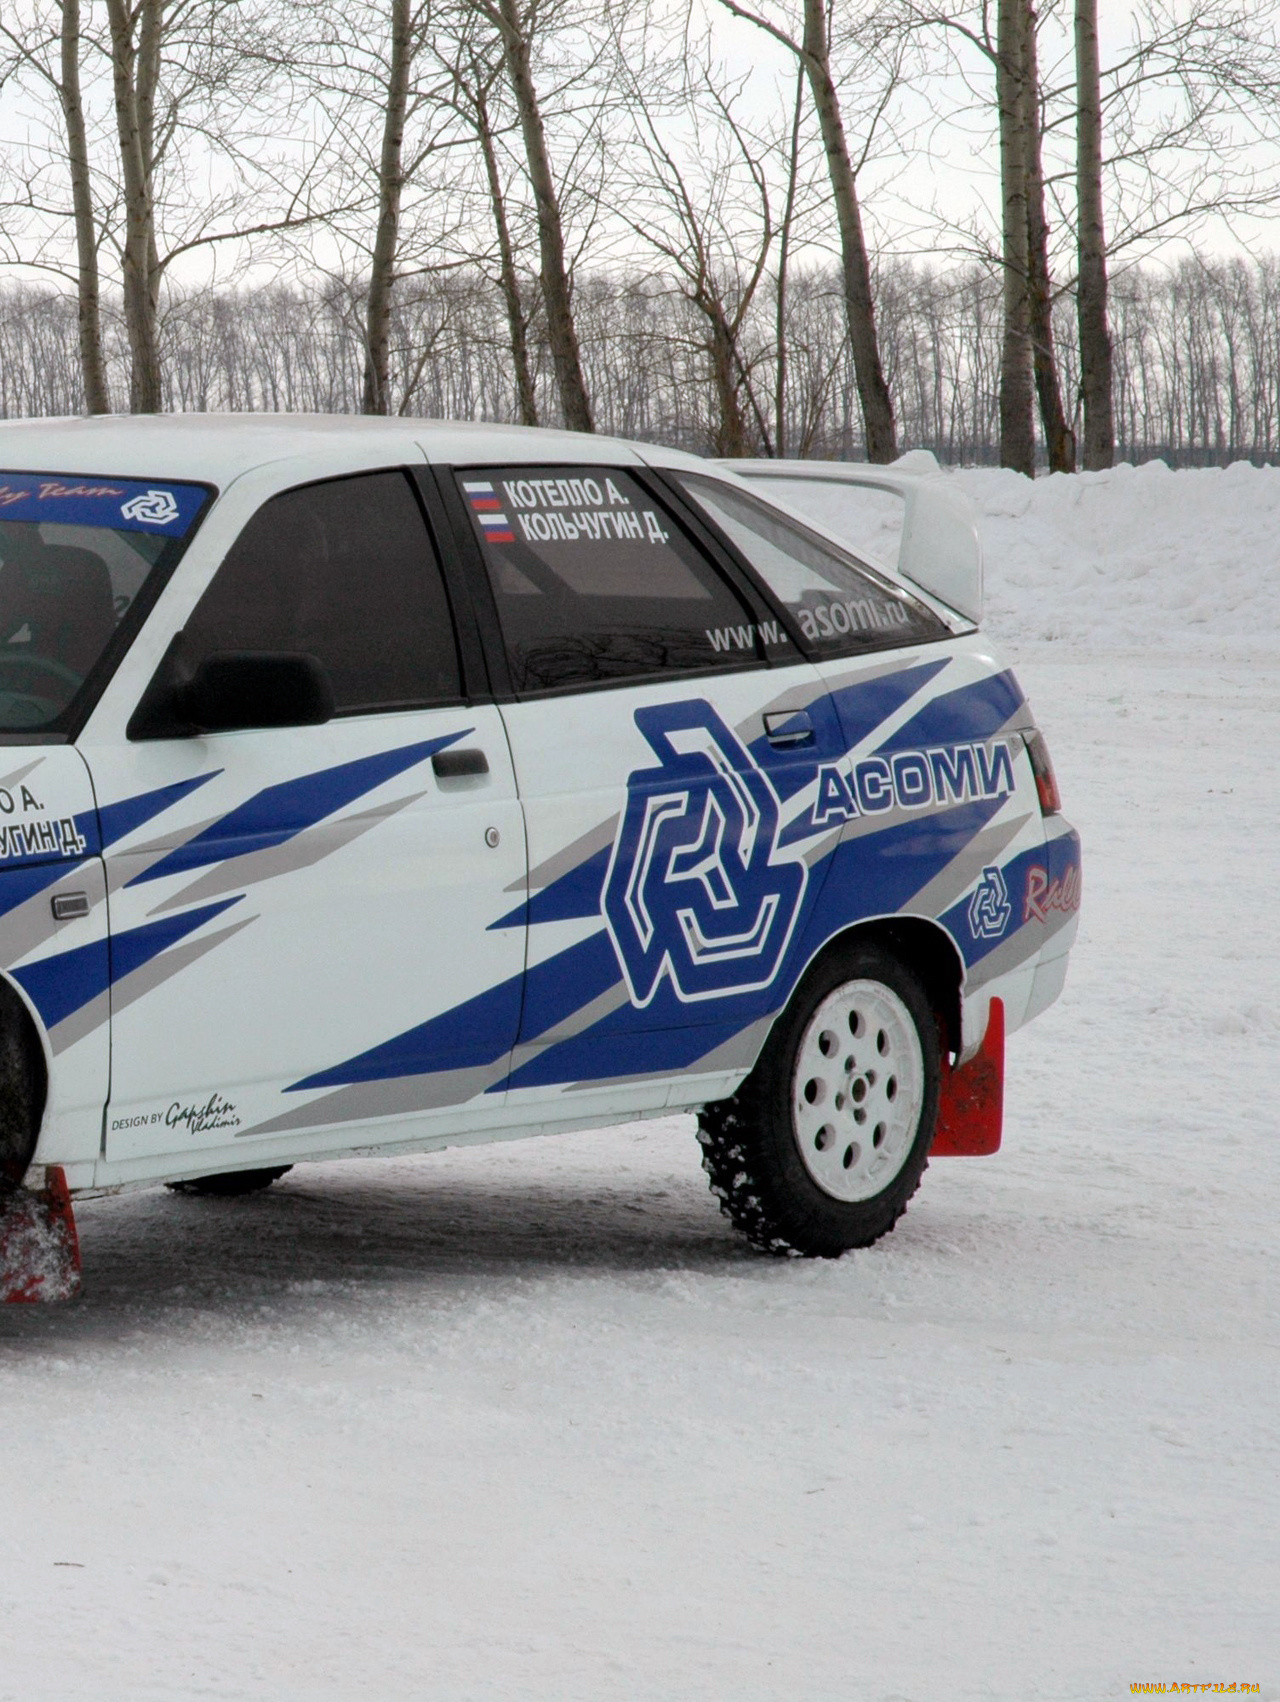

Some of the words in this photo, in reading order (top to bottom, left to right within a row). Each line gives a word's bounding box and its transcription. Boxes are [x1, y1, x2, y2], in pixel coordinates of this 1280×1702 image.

[38, 482, 123, 499] Team
[502, 478, 604, 509] КОТЕЛЛО
[604, 478, 630, 505] А.
[517, 511, 644, 541] КОЛЬЧУГИН
[642, 511, 670, 544] Д.
[19, 784, 45, 812] А.
[811, 740, 1016, 825] АСОМИ
[58, 817, 86, 855] Д.
[111, 1115, 149, 1131] DESIGN
[150, 1112, 164, 1124] BY
